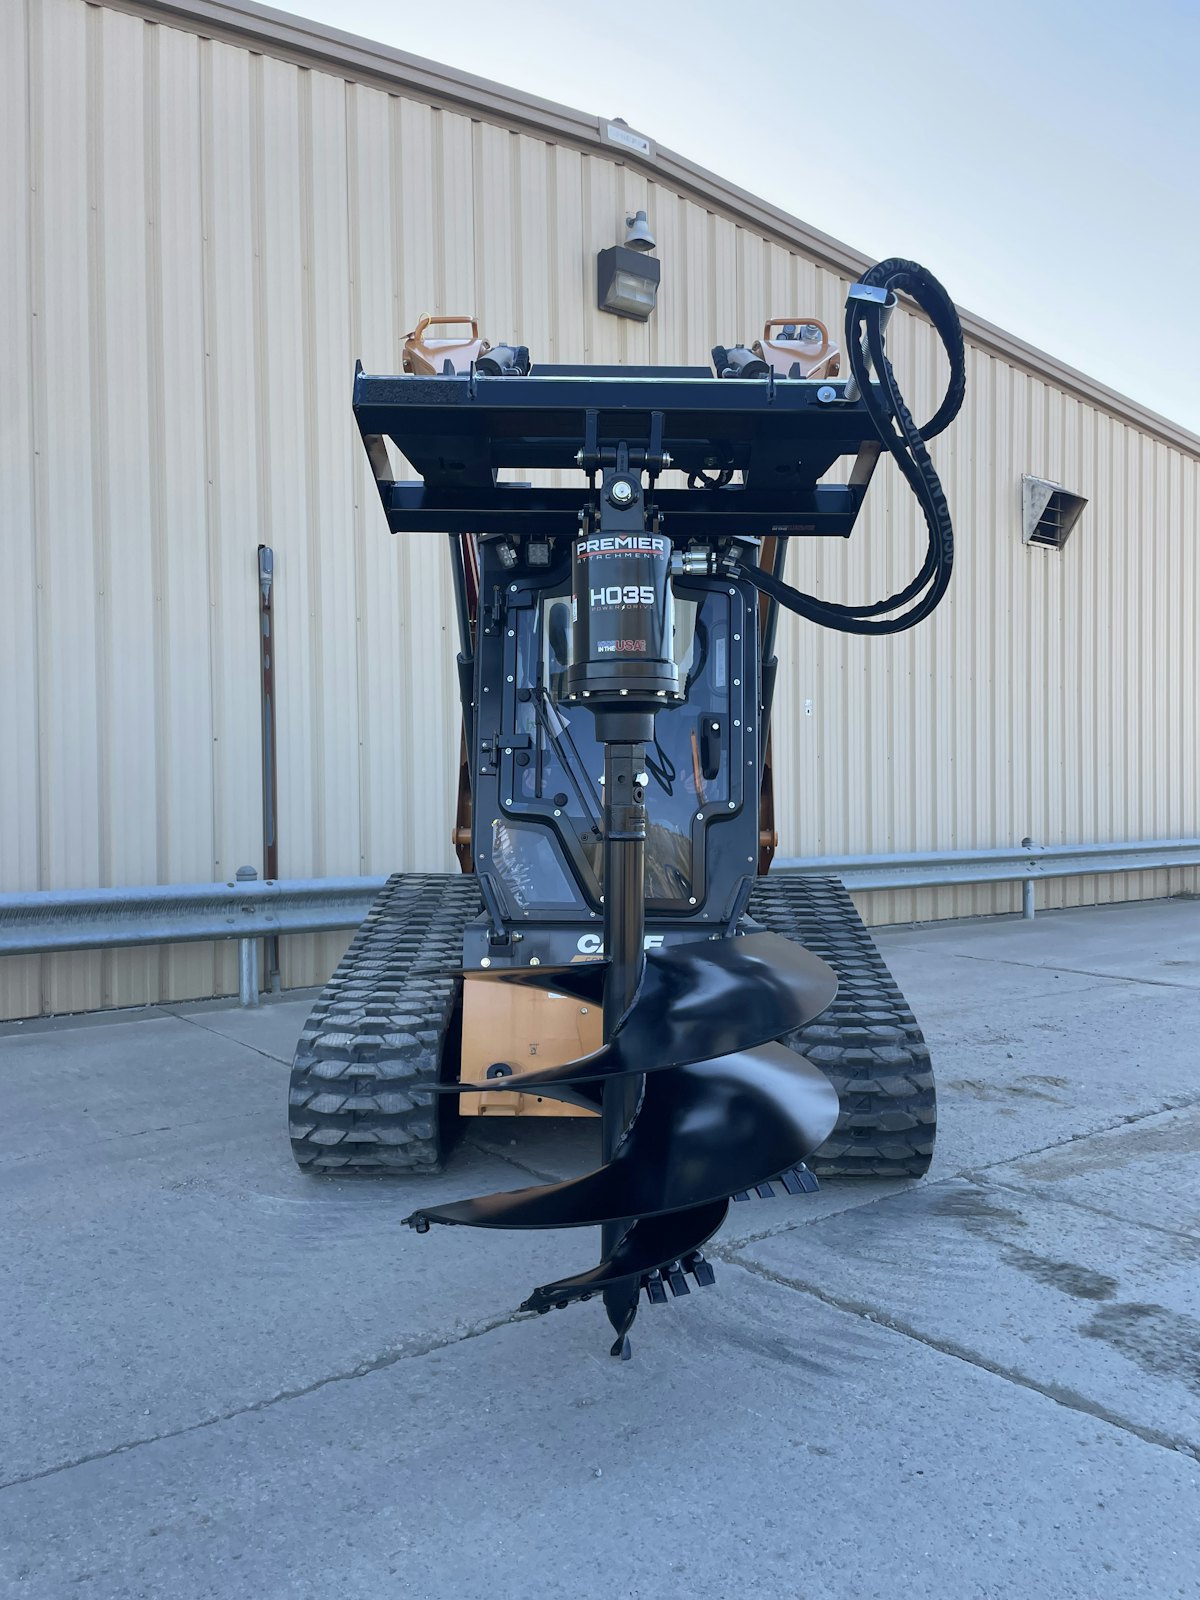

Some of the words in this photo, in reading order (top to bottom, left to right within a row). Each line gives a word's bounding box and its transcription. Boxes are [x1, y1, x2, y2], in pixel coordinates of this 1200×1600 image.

[577, 537, 664, 555] PREMIER
[577, 552, 665, 564] ATTACHMENTS
[591, 604, 621, 612] POWER
[615, 639, 643, 652] USA
